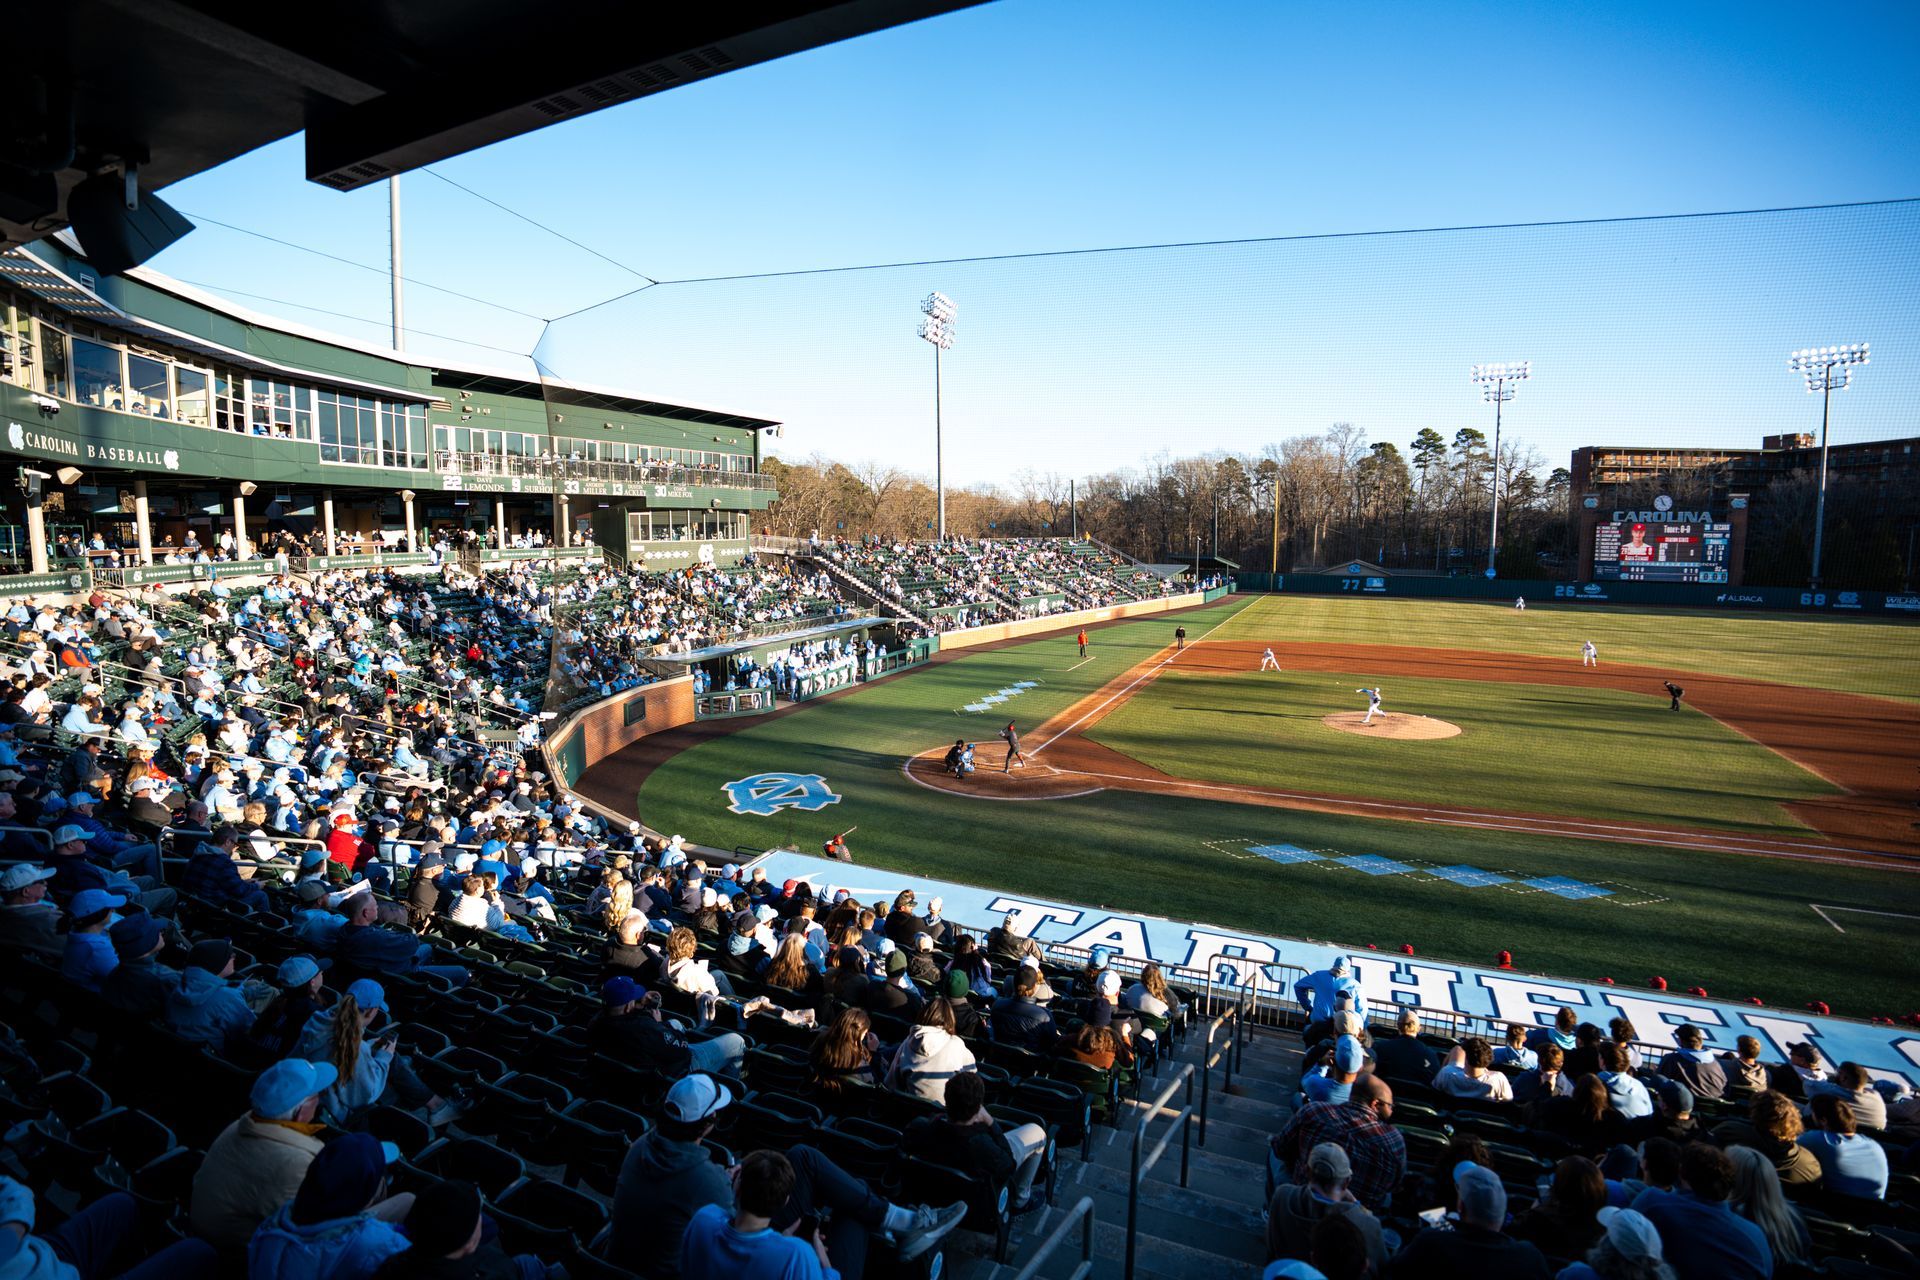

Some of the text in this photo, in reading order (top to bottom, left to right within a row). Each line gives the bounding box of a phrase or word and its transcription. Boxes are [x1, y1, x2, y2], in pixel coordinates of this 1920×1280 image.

[26, 432, 79, 456] CAROLINA
[88, 445, 162, 465] BASEBALL
[443, 475, 462, 490] 22
[464, 483, 505, 492] LEMONDS
[512, 478, 521, 491] 9
[564, 481, 580, 493] 33
[583, 487, 607, 495] MILLER
[613, 483, 623, 495] 13
[624, 489, 647, 497] ACKLEY
[655, 485, 667, 497] 30
[1613, 511, 1713, 523] CAROLINA
[1342, 579, 1360, 590] 77
[1555, 585, 1575, 597] 26
[1727, 595, 1764, 603] ALPACA
[1801, 593, 1826, 605] 68
[985, 897, 1920, 1090] TAR HEEL
